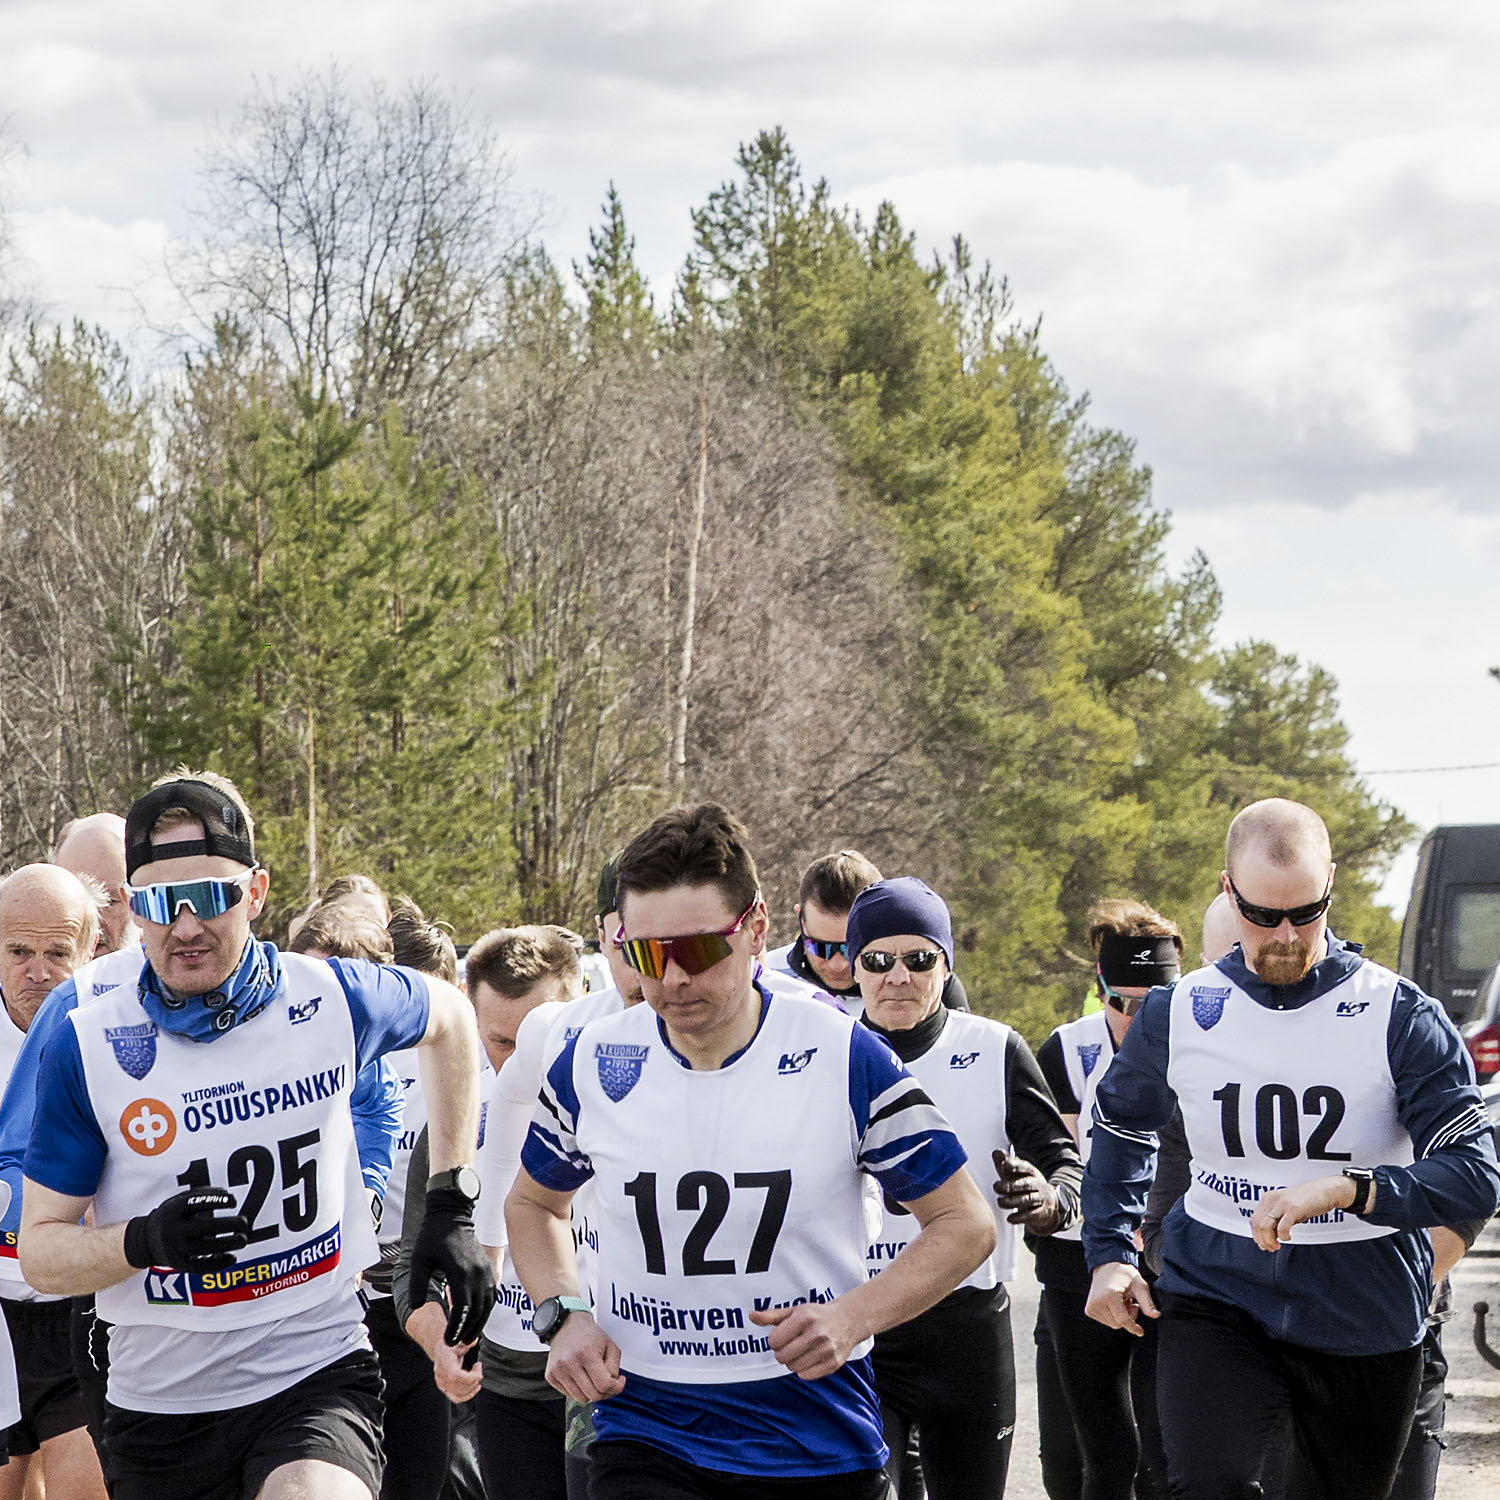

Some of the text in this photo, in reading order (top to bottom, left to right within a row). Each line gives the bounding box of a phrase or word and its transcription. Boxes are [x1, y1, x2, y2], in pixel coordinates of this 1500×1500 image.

[607, 1044, 638, 1056] KUOHU
[611, 1059, 631, 1070] 1913
[181, 1080, 245, 1103] YLITORNION
[183, 1064, 346, 1132] OSUUSPANKKI
[1212, 1082, 1352, 1161] 102
[624, 1169, 792, 1277] 127
[149, 1232, 340, 1299] K SUPERMARKET
[252, 1271, 309, 1298] YLITORNIO
[611, 1282, 745, 1336] Lohijärven
[659, 1334, 772, 1357] www.kuohu
